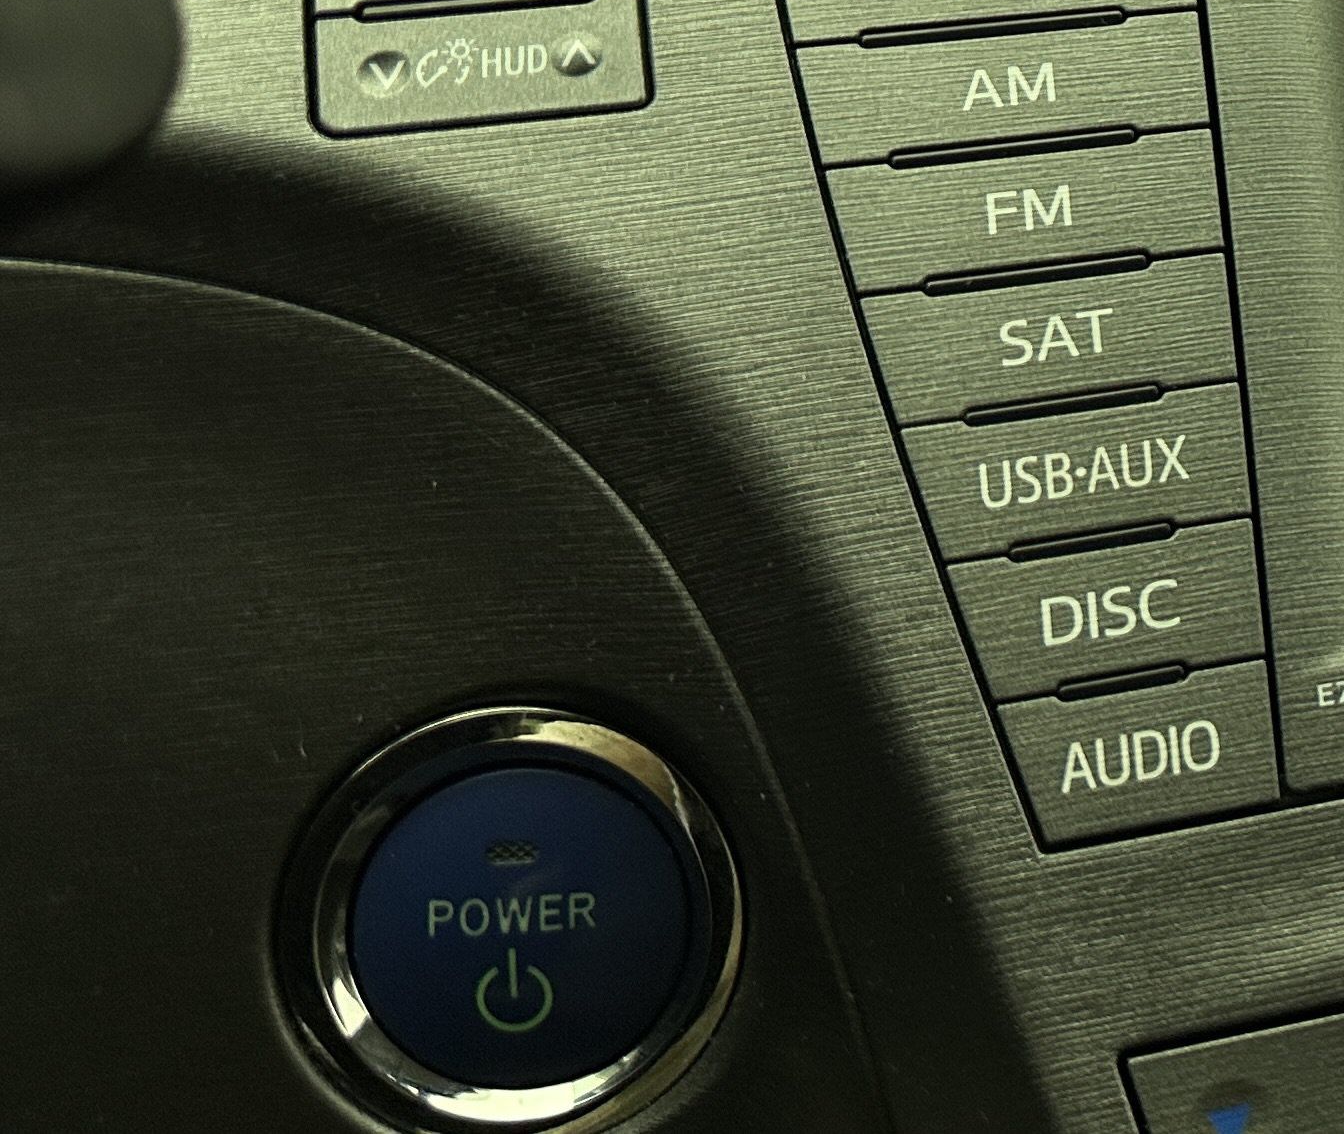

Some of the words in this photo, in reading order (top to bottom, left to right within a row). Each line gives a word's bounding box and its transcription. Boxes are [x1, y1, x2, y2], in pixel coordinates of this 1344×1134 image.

[479, 43, 550, 80] HUD
[962, 62, 1058, 112] AM
[984, 184, 1075, 236] FM
[999, 307, 1113, 367] SAT
[1039, 578, 1182, 648] DISC
[1059, 719, 1222, 795] AUDIO
[426, 891, 597, 939] POWER
